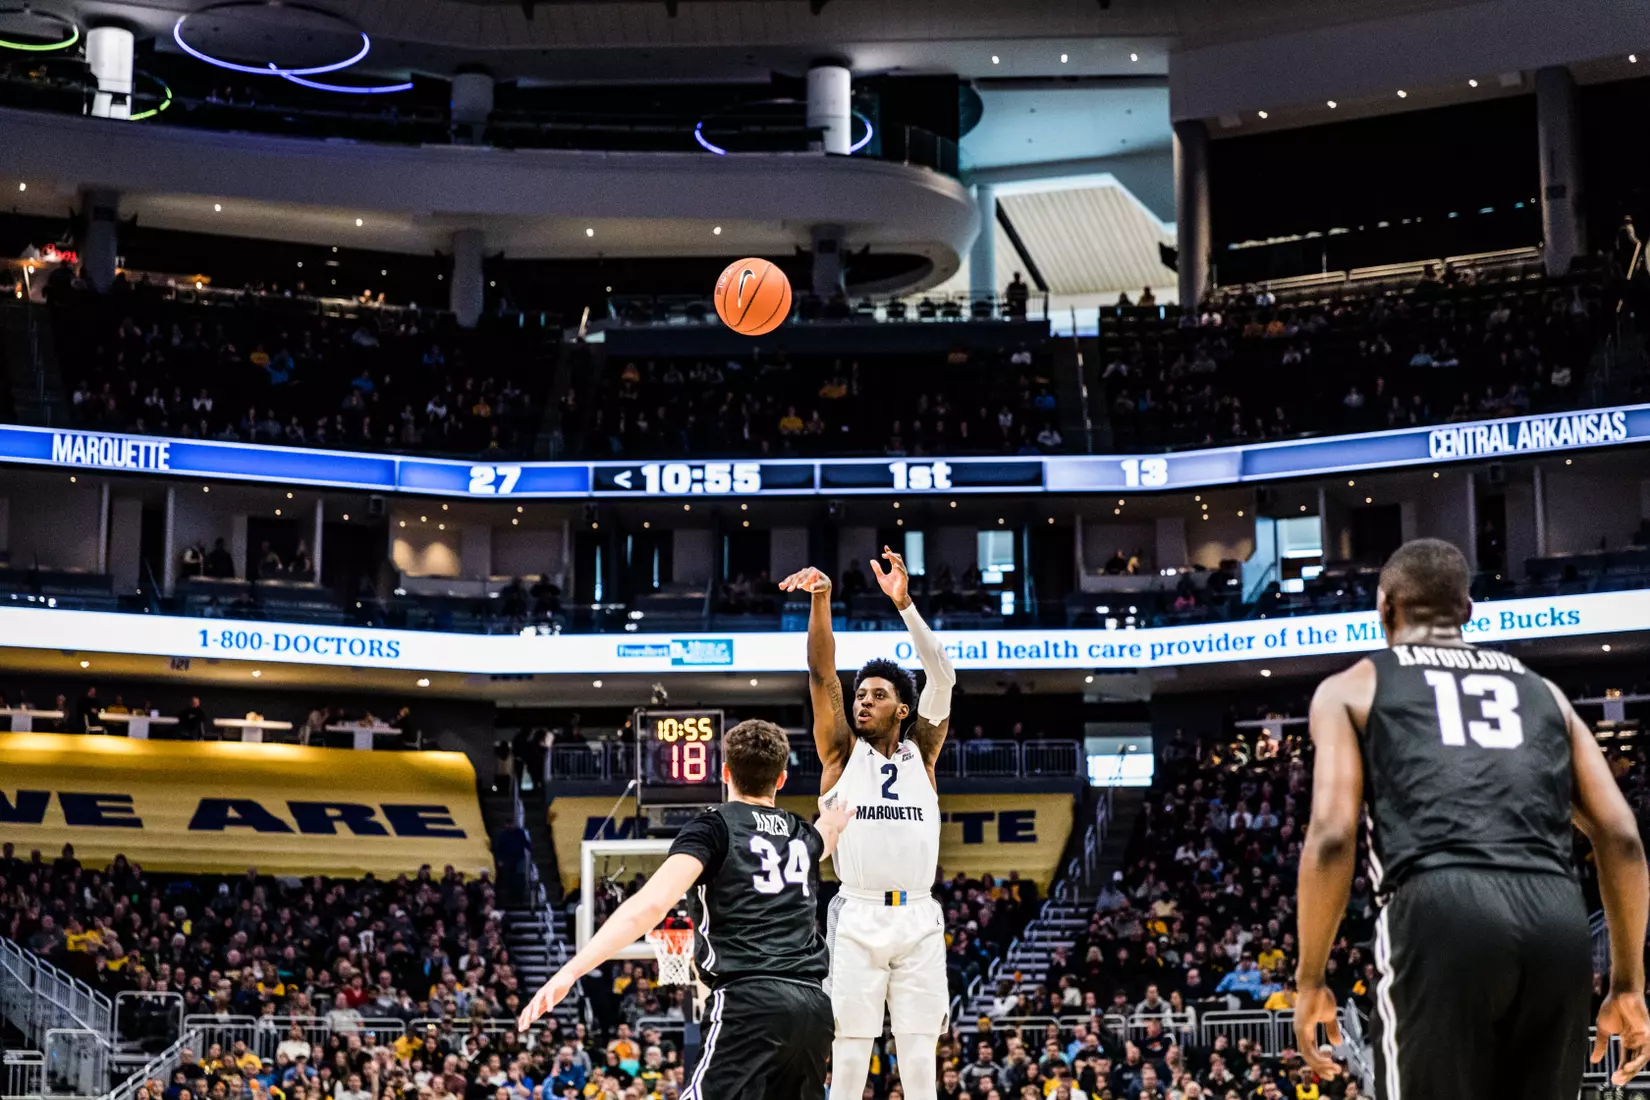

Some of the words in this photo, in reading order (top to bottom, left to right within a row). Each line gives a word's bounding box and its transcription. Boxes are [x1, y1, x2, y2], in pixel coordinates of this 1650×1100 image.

[52, 433, 170, 470] MARQUETTE
[1429, 422, 1515, 459] CENTRAL
[1516, 410, 1627, 450] ARKANSAS
[469, 465, 522, 495] 27
[641, 463, 761, 495] 10:55
[889, 460, 951, 490] 1st
[1121, 458, 1168, 488] 13
[198, 629, 401, 659] 1-800-DOCTORS
[895, 640, 988, 660] Ocial
[997, 639, 1079, 659] health
[1088, 642, 1142, 659] care
[1150, 632, 1256, 661] provider
[1264, 627, 1288, 648] of
[1296, 625, 1338, 646] the
[1346, 616, 1490, 642] Milee
[1499, 607, 1581, 631] Bucks
[1424, 669, 1524, 749] 13
[657, 717, 713, 742] 10:55
[672, 742, 706, 781] 18
[880, 763, 899, 801] 2
[188, 797, 467, 839] ARE
[855, 805, 924, 821] MARQUETTE
[749, 834, 810, 897] 34
